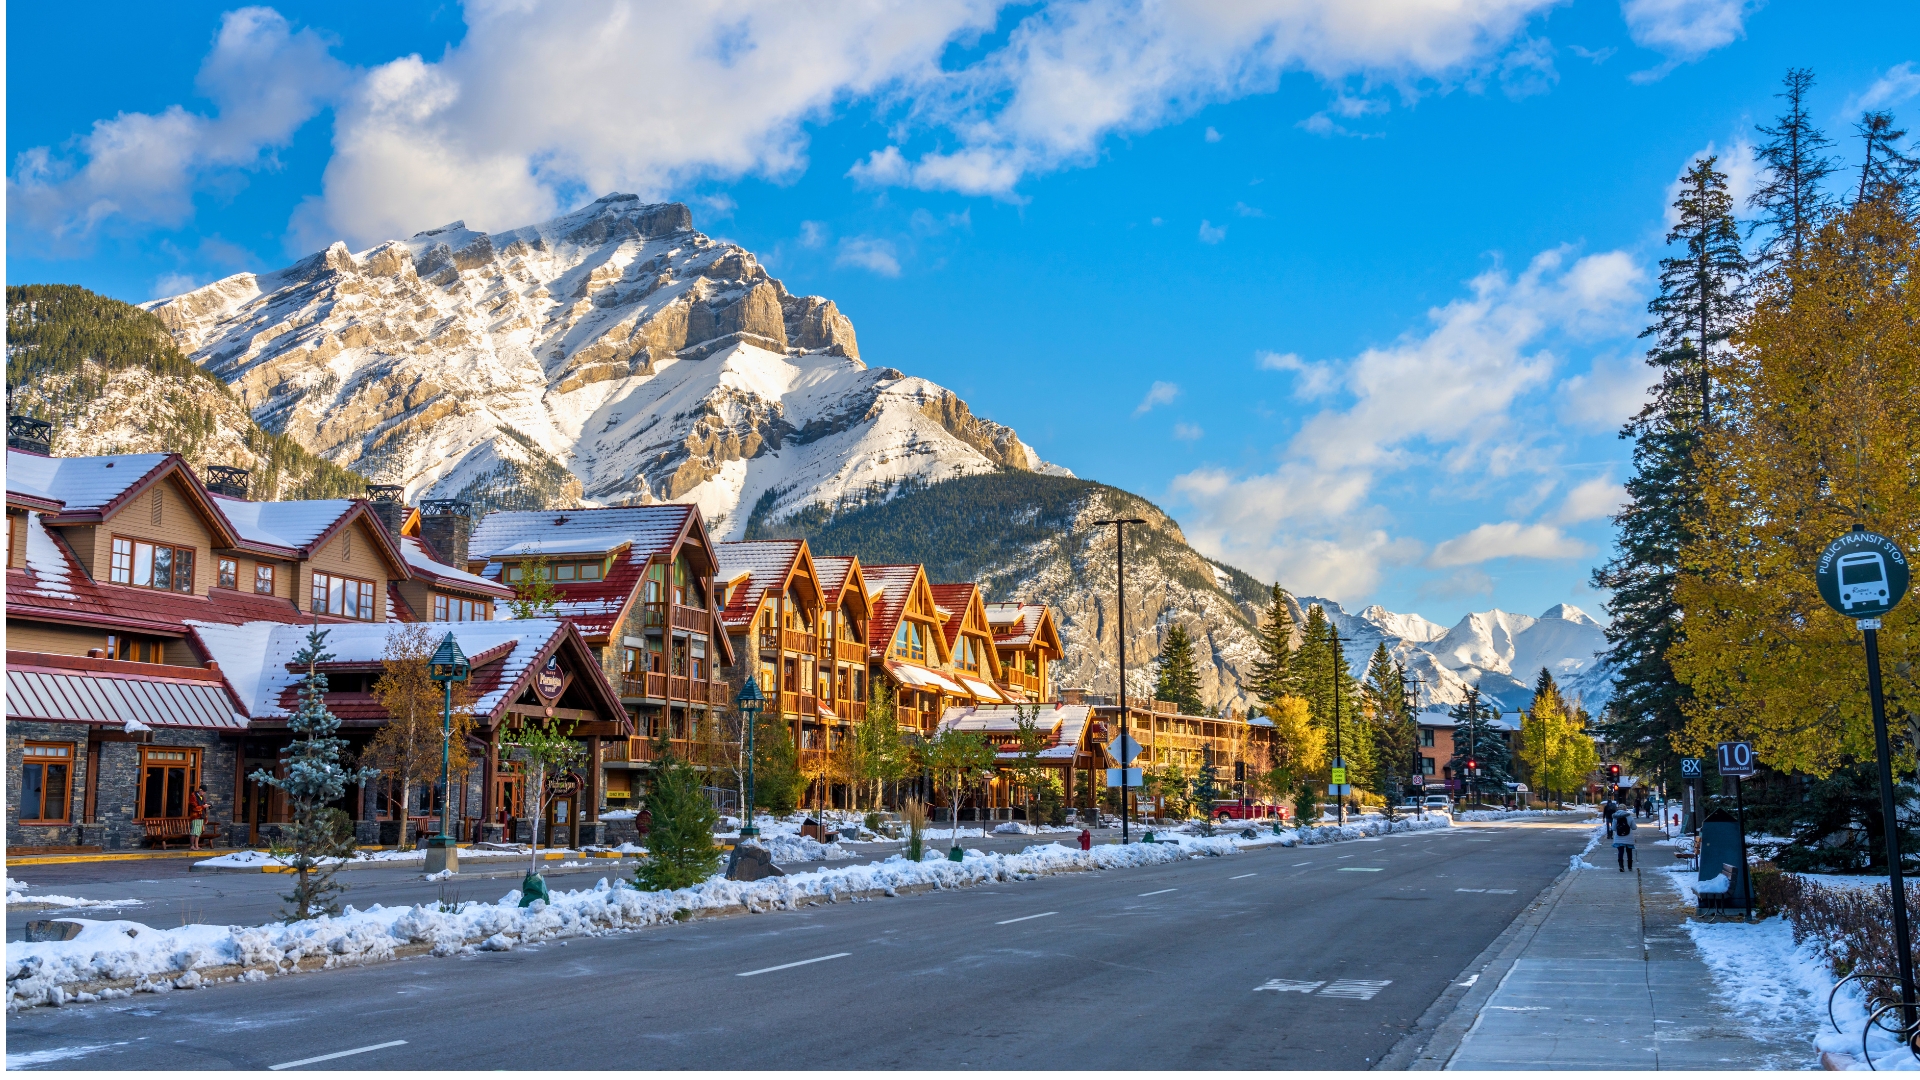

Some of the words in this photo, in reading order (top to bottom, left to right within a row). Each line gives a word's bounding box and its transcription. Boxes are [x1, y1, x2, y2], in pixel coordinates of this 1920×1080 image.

[1819, 542, 1841, 574] PUBLIC
[1839, 533, 1885, 546] TRANSIT
[1883, 542, 1904, 565] STOP
[1682, 759, 1701, 773] 8X
[1719, 743, 1750, 767] 10
